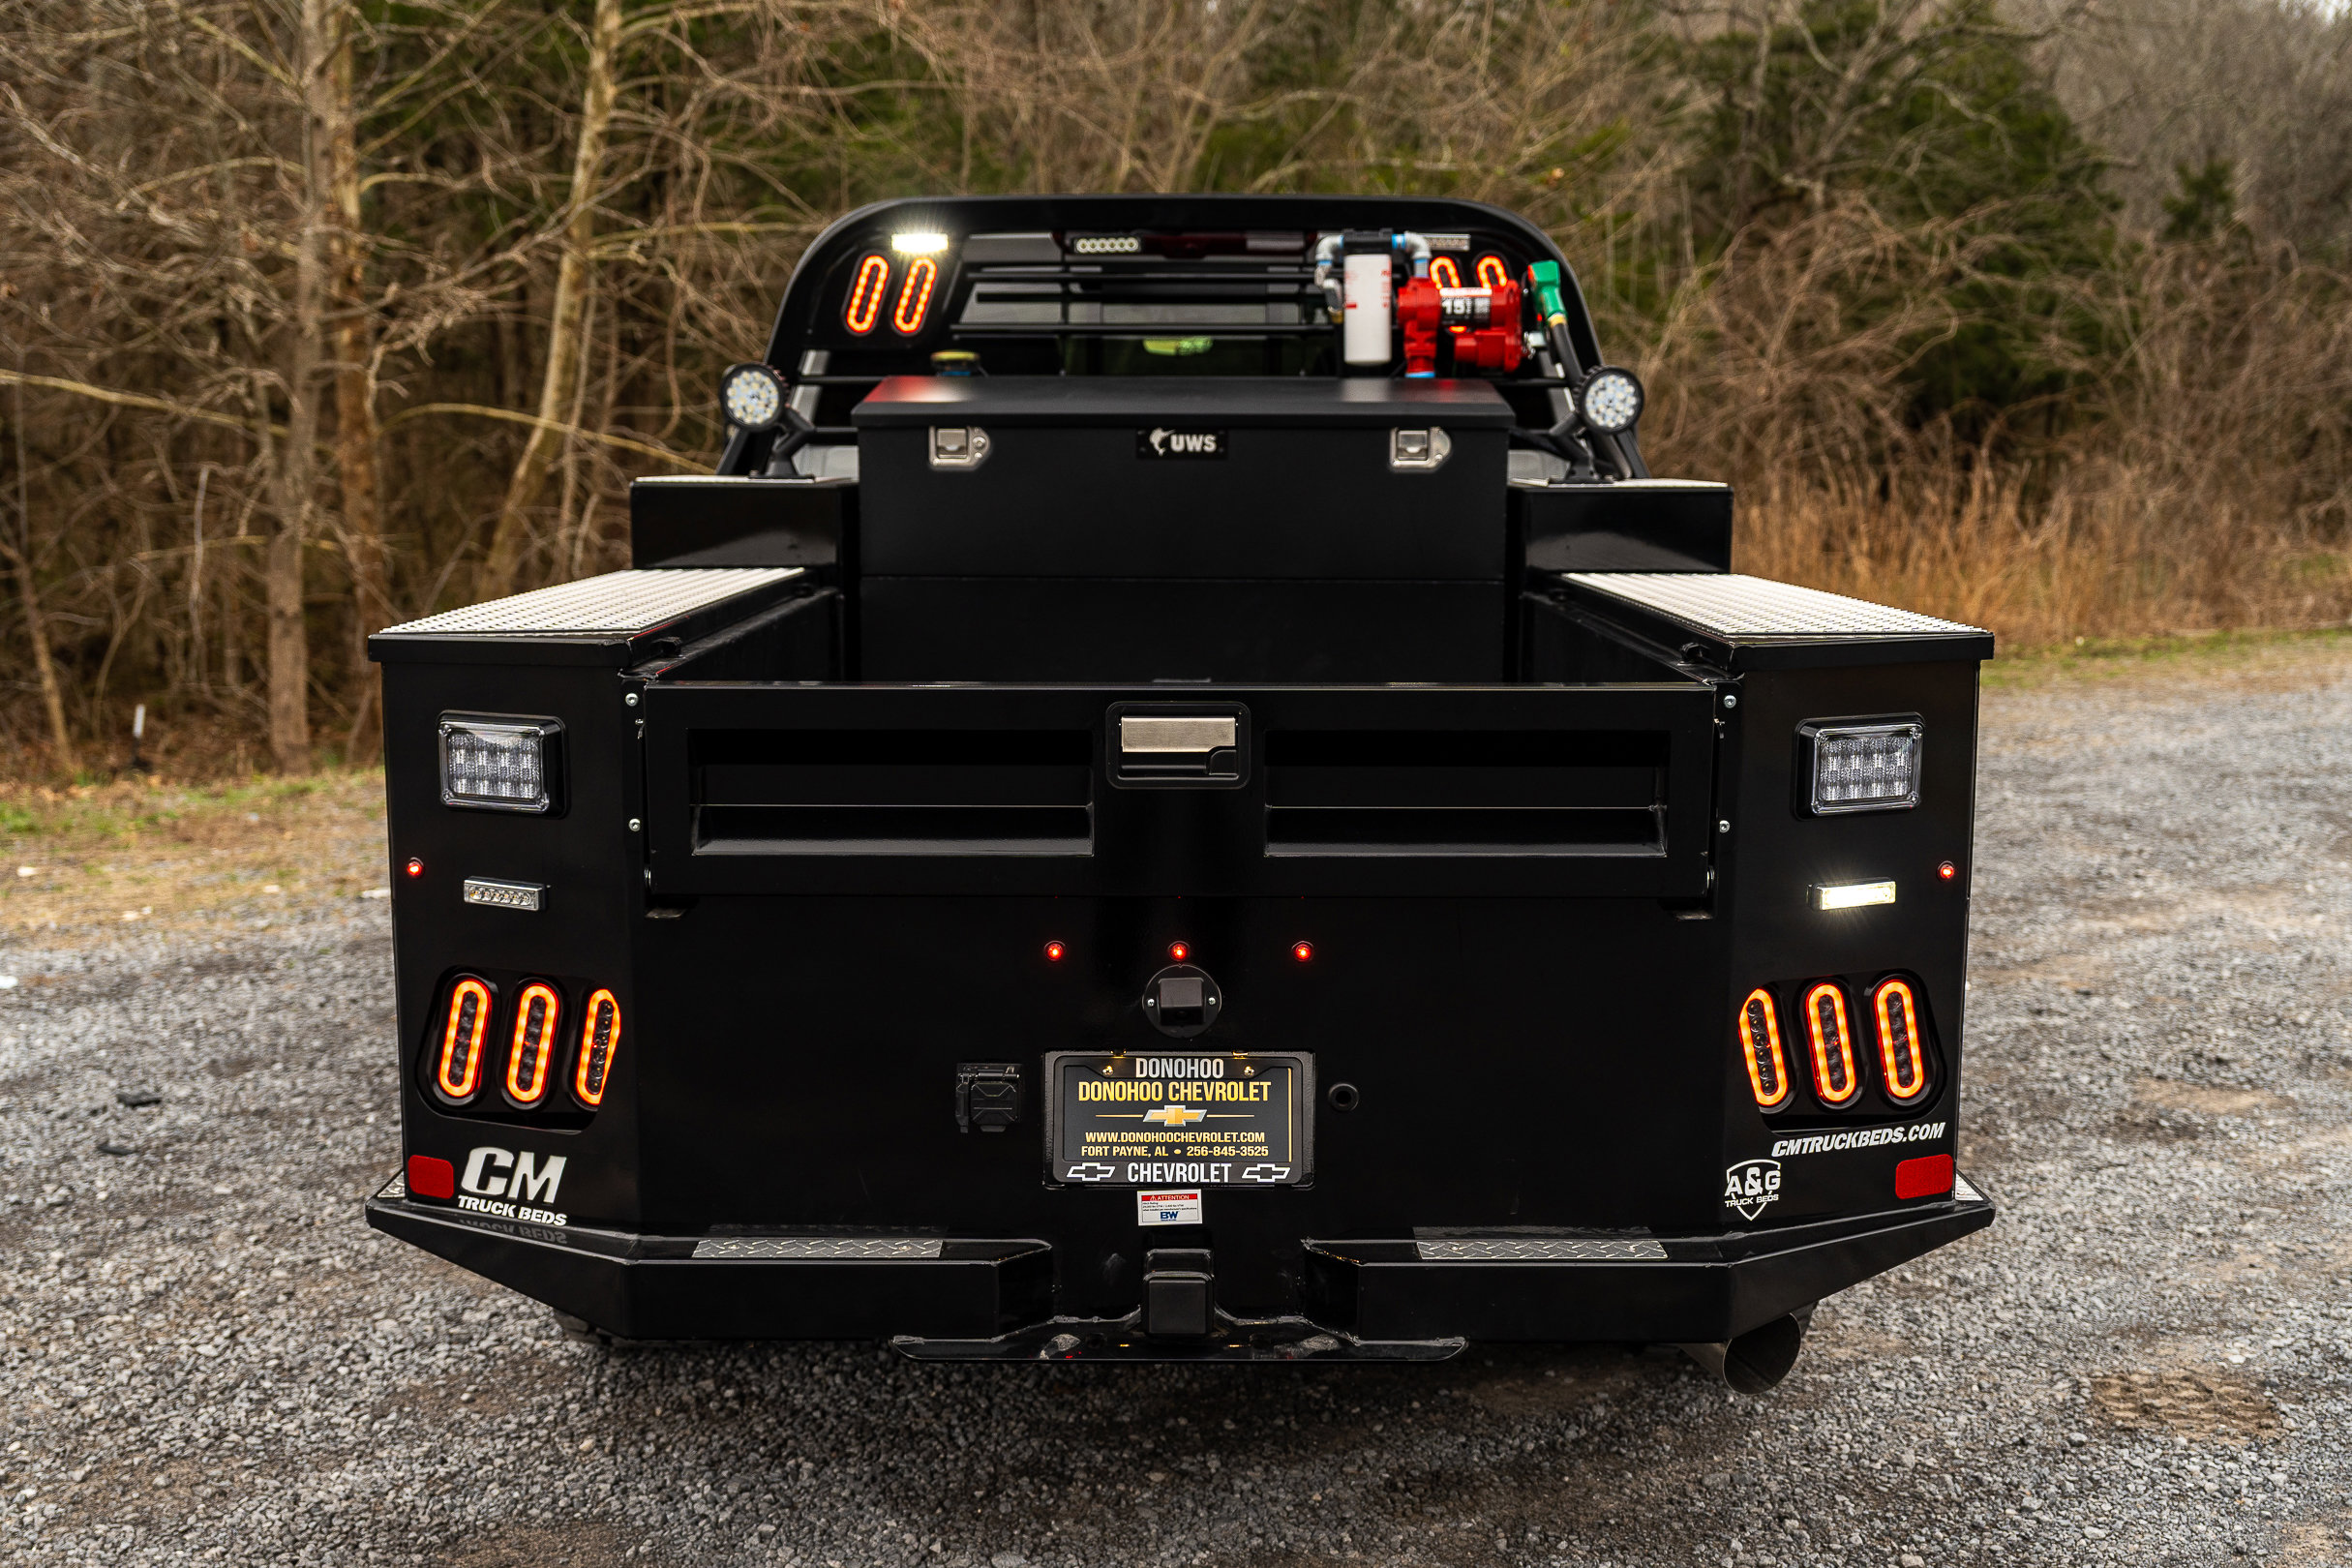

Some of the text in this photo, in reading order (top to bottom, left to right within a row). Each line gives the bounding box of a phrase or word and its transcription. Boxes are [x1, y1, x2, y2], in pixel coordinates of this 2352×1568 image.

[1170, 434, 1217, 452] UWS
[1135, 1058, 1224, 1078] DONOHOO
[1078, 1081, 1272, 1101] DONOHOO CHEVROLET
[1085, 1131, 1265, 1143] WWW.DONOHOOCHEVROLET.COM
[1771, 1122, 1945, 1157] CMTRUCKBEDS.COM
[1081, 1146, 1269, 1159] FORT PAYNE, AL 256-845-3525
[461, 1146, 567, 1204] CM
[1127, 1162, 1232, 1183] CHEVROLET
[1724, 1166, 1781, 1196] A&G
[458, 1194, 567, 1226] TRUCK BEDS
[1724, 1193, 1779, 1208] TRUCK BEDS
